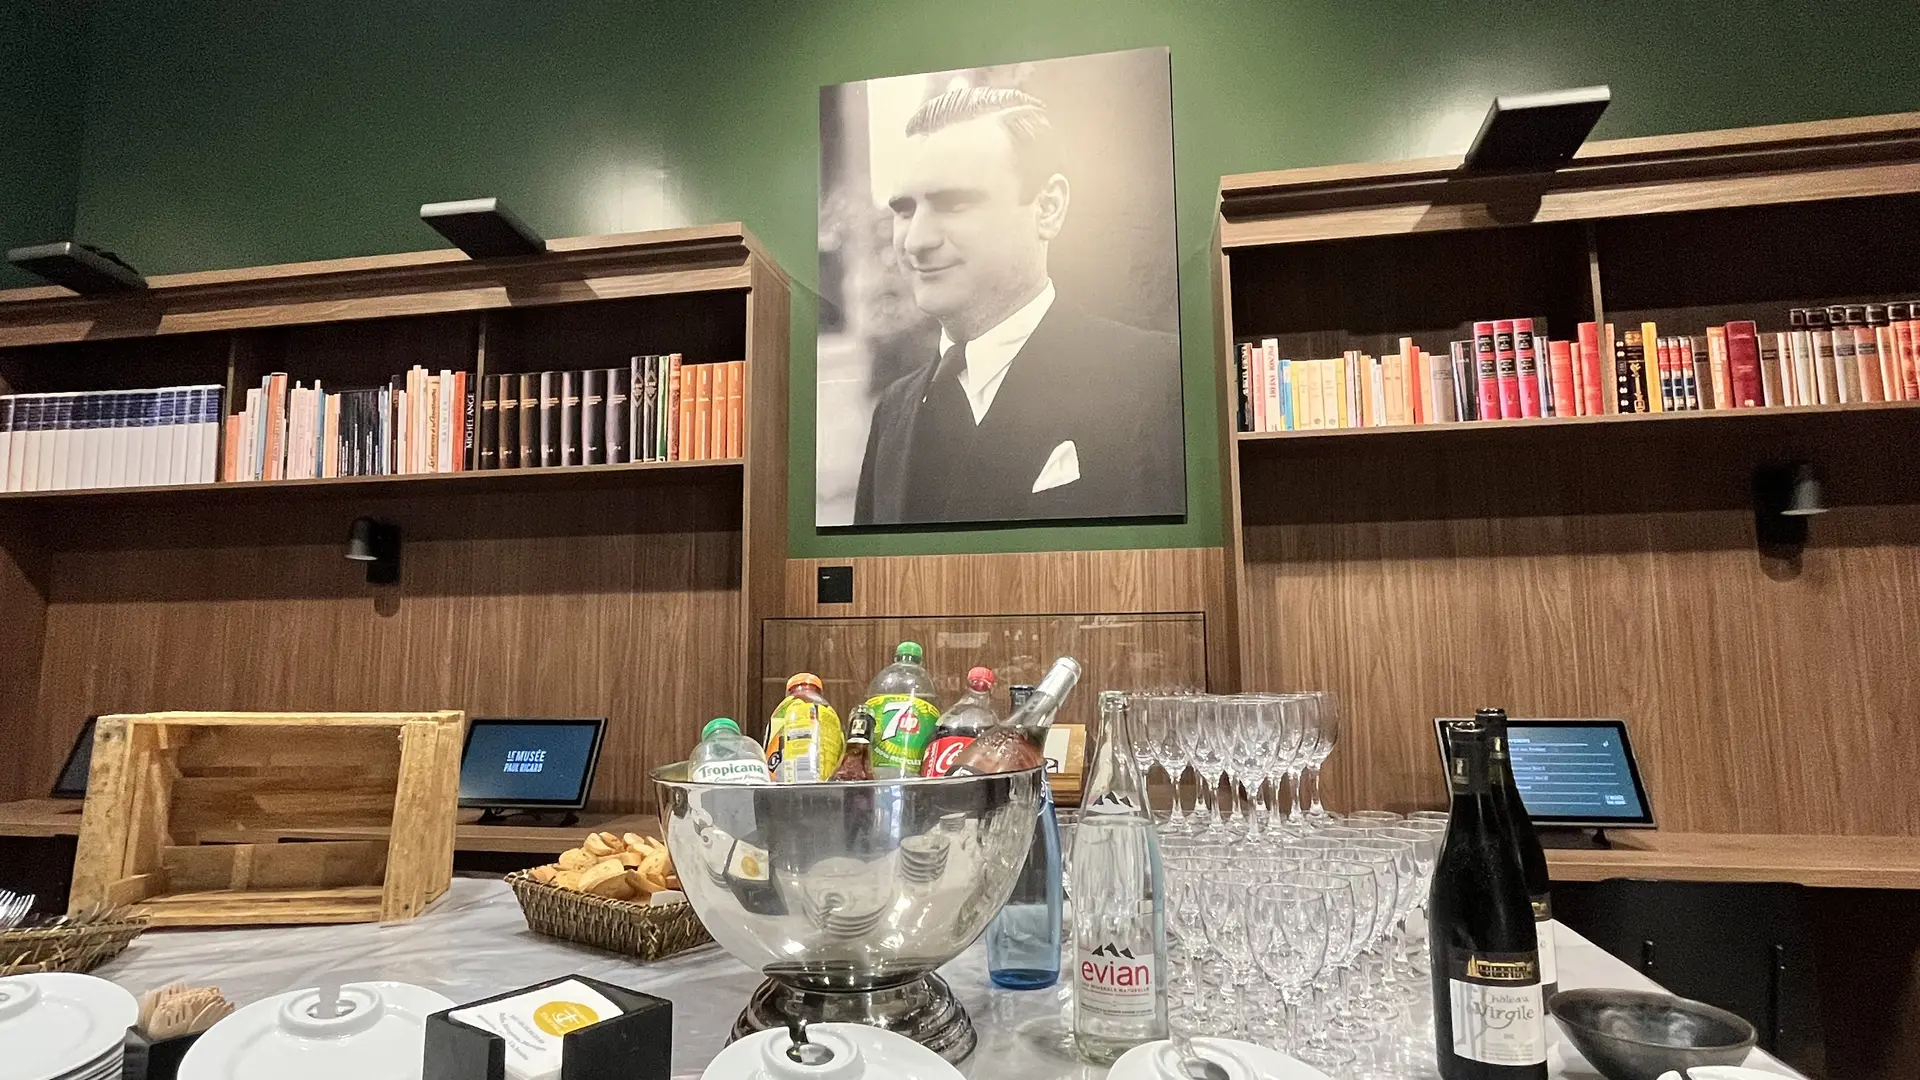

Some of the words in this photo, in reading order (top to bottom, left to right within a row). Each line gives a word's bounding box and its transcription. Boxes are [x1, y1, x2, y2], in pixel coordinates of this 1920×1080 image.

[507, 750, 516, 761] LE
[516, 749, 547, 762] MUSÉE
[503, 762, 519, 773] PAUL
[519, 762, 543, 773] RICARD
[698, 763, 765, 778] Tropicana
[1081, 960, 1150, 986] evian
[1473, 1002, 1535, 1029] Virgile
